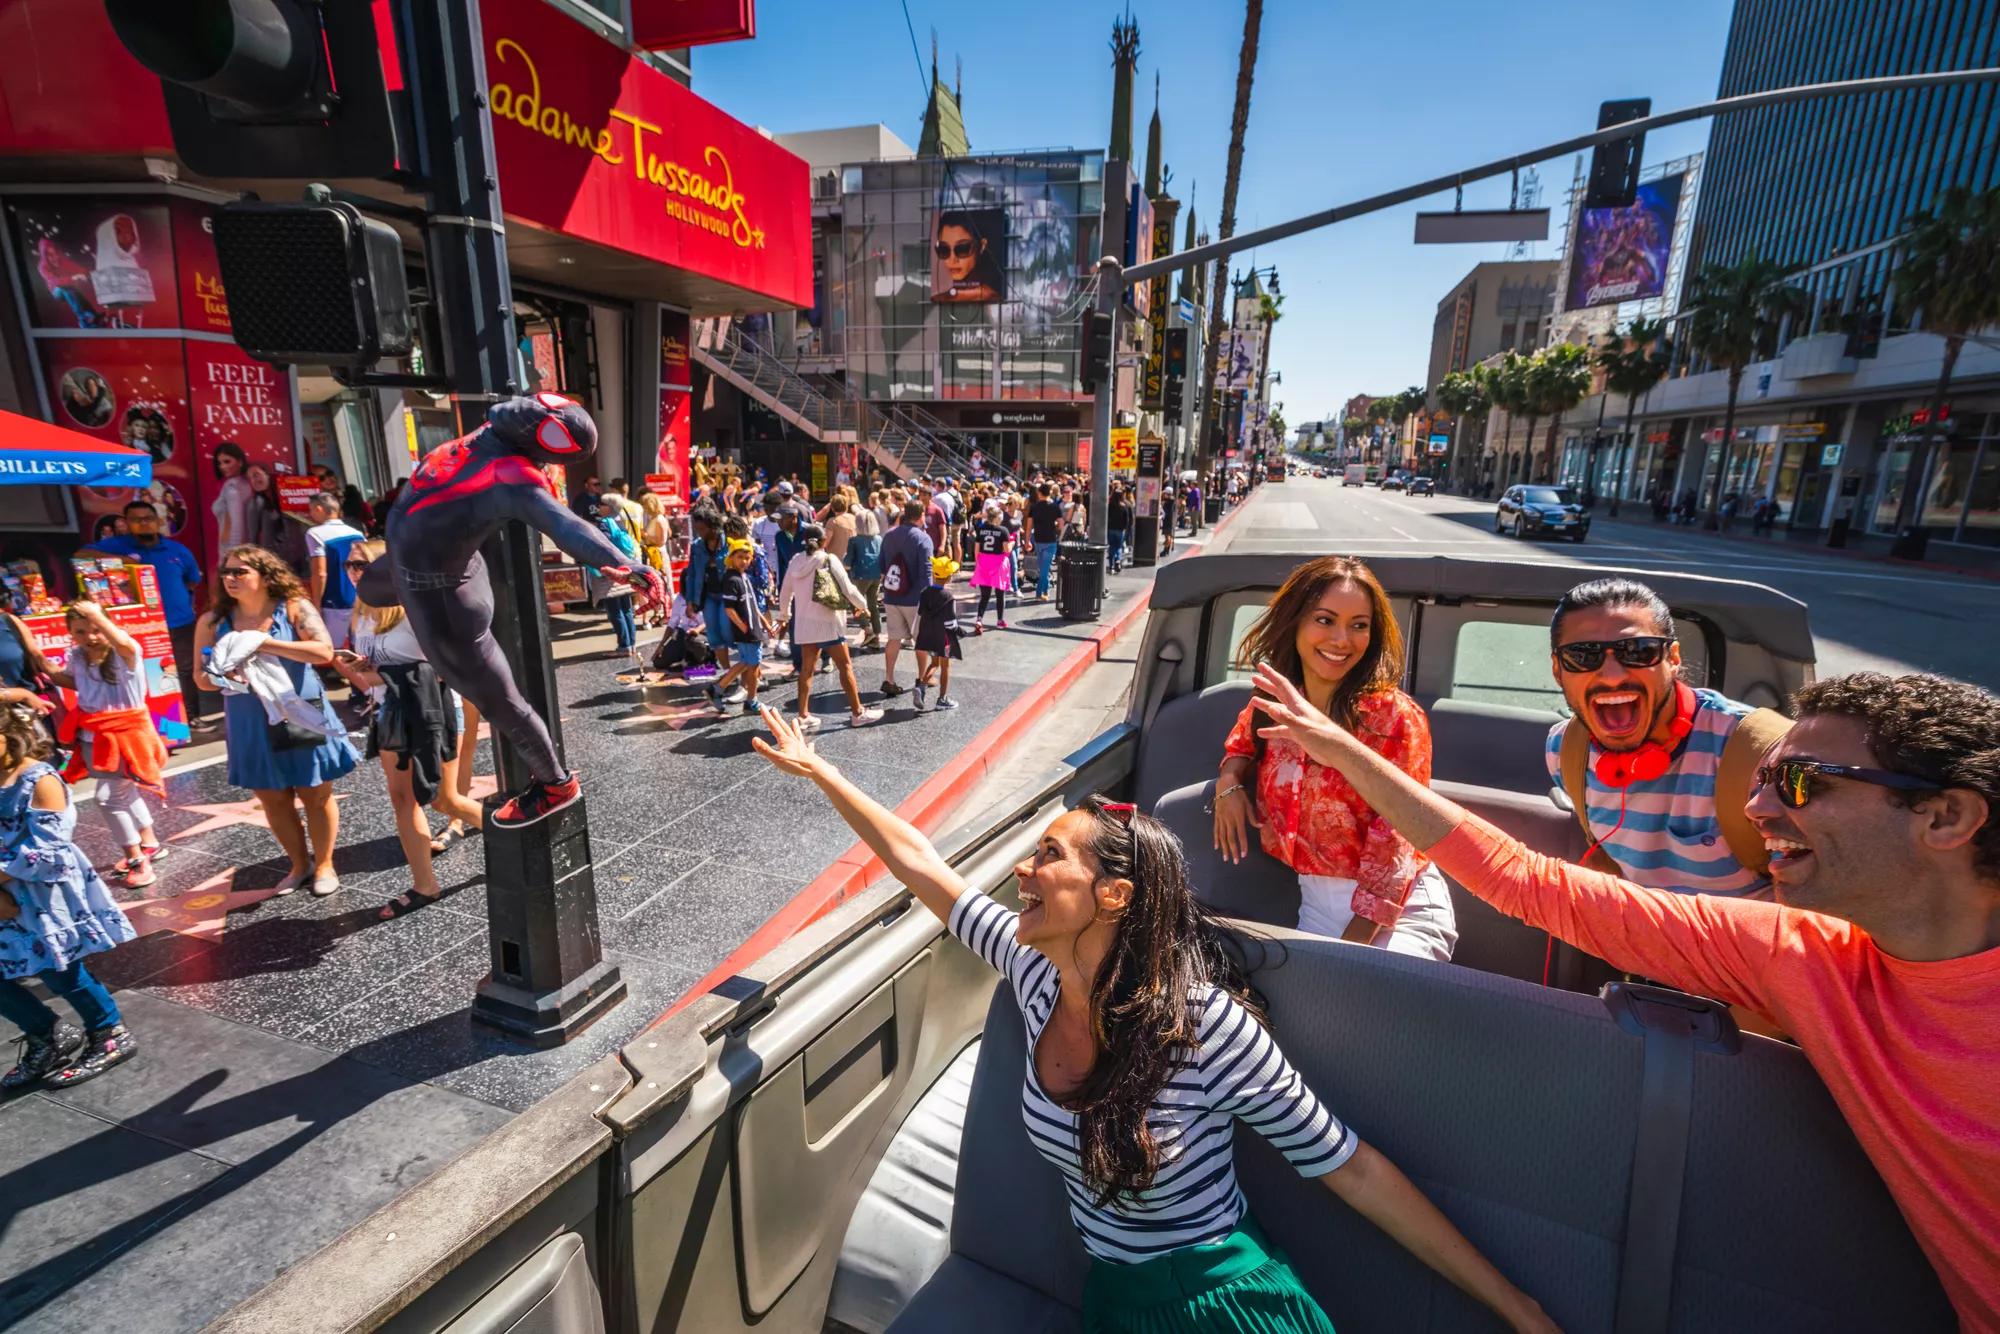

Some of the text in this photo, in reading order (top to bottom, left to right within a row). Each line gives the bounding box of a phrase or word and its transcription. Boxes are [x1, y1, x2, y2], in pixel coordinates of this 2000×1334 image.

[489, 37, 752, 247] adame Tussauds
[666, 198, 730, 238] HOLLYWOOD
[206, 362, 275, 386] FEEL
[212, 384, 272, 406] THE
[206, 404, 283, 426] FAME!
[1115, 439, 1133, 459] 5
[983, 535, 995, 552] 2
